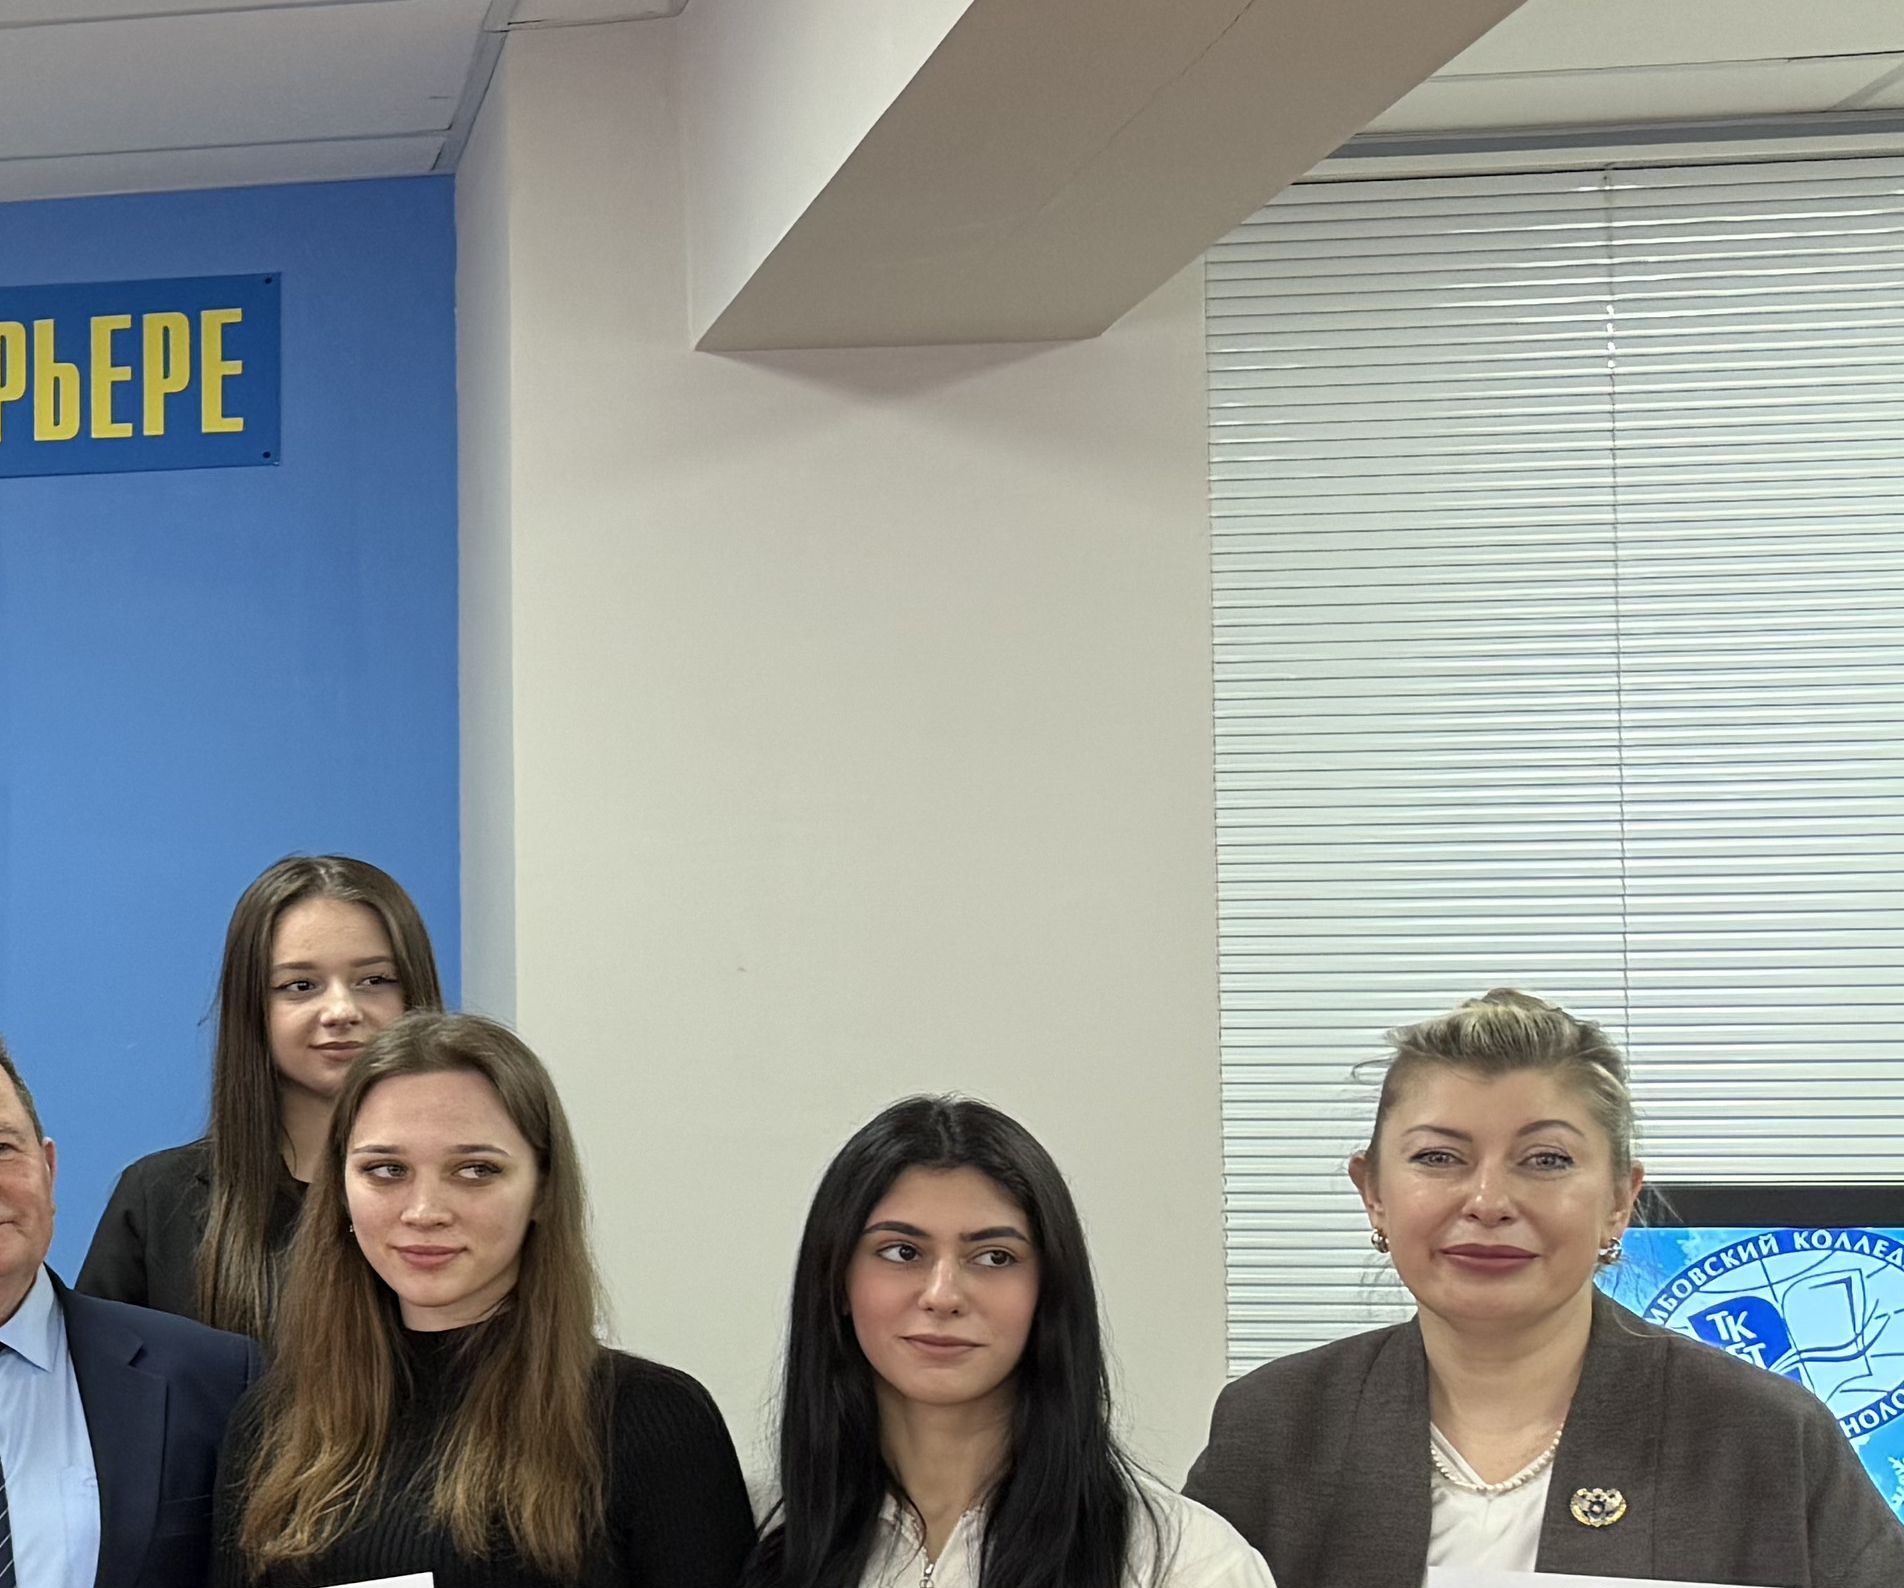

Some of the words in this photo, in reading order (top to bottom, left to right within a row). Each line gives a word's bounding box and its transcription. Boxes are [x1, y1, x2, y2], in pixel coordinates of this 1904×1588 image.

[1646, 1233, 1780, 1326] МБОВСКИЙ
[1793, 1229, 1904, 1267] КОЛЛЕД
[1706, 1310, 1757, 1342] ТК
